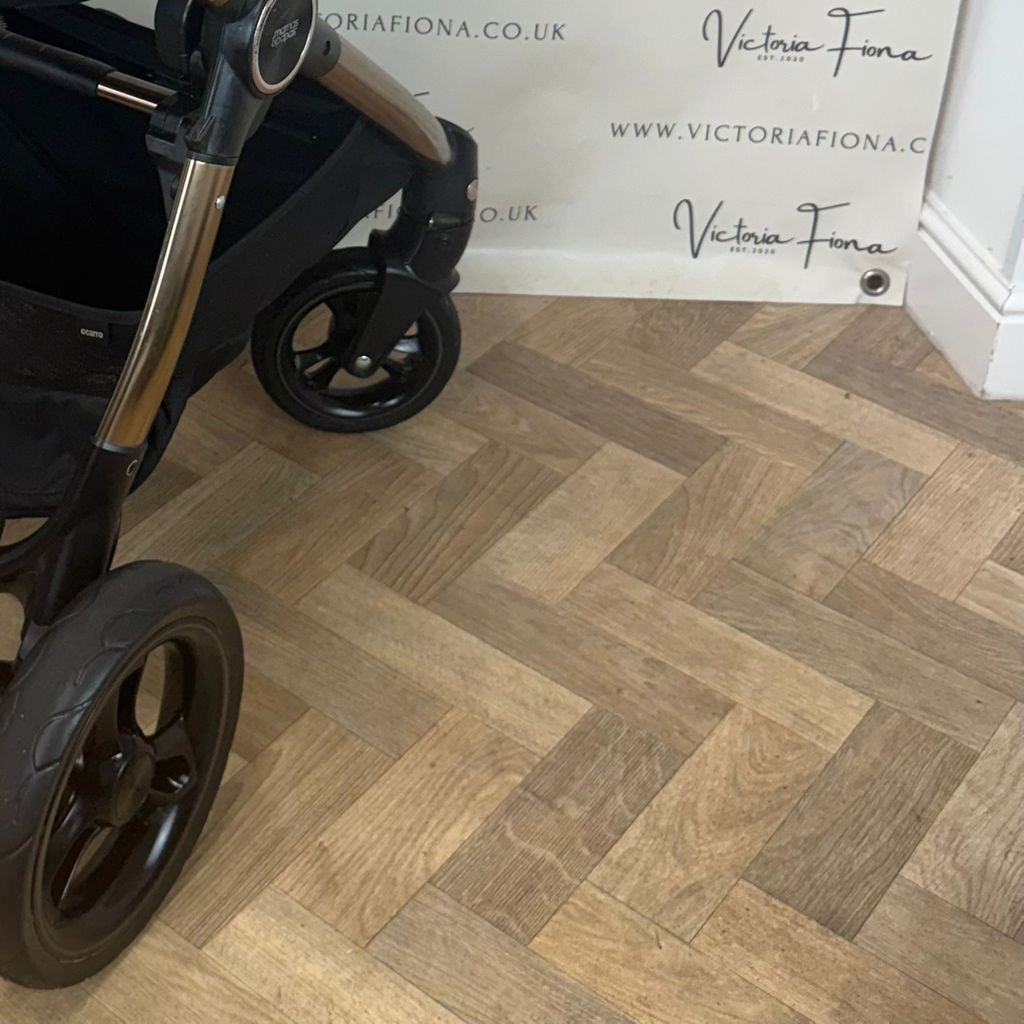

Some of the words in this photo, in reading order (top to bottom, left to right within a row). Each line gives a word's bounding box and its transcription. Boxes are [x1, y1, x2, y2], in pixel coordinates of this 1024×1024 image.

[702, 9, 825, 67] Victoria
[827, 8, 933, 77] Fiona
[673, 199, 794, 259] Victoria
[797, 202, 897, 269] Fiona
